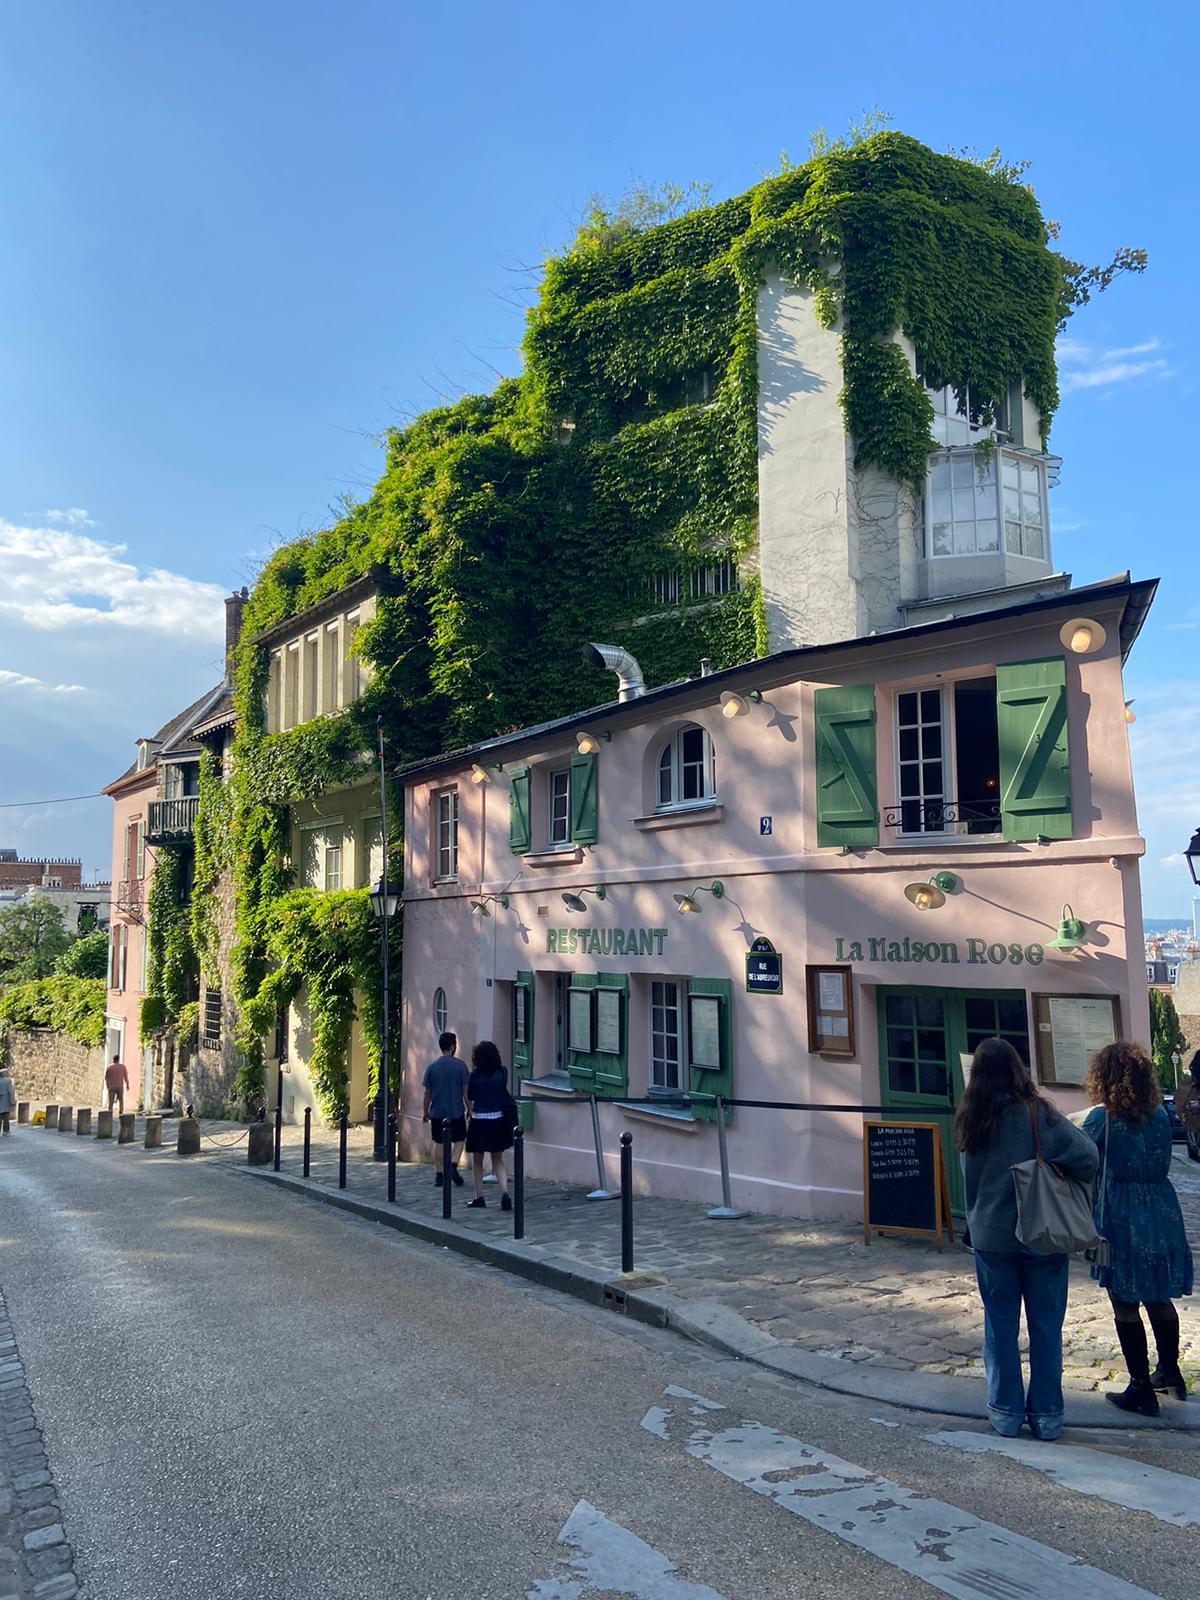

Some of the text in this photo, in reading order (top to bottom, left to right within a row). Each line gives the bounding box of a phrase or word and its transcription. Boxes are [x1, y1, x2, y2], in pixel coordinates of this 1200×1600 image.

[763, 818, 770, 834] 2
[546, 928, 668, 955] RESTAURANT
[836, 937, 1045, 965] La Maison Rose
